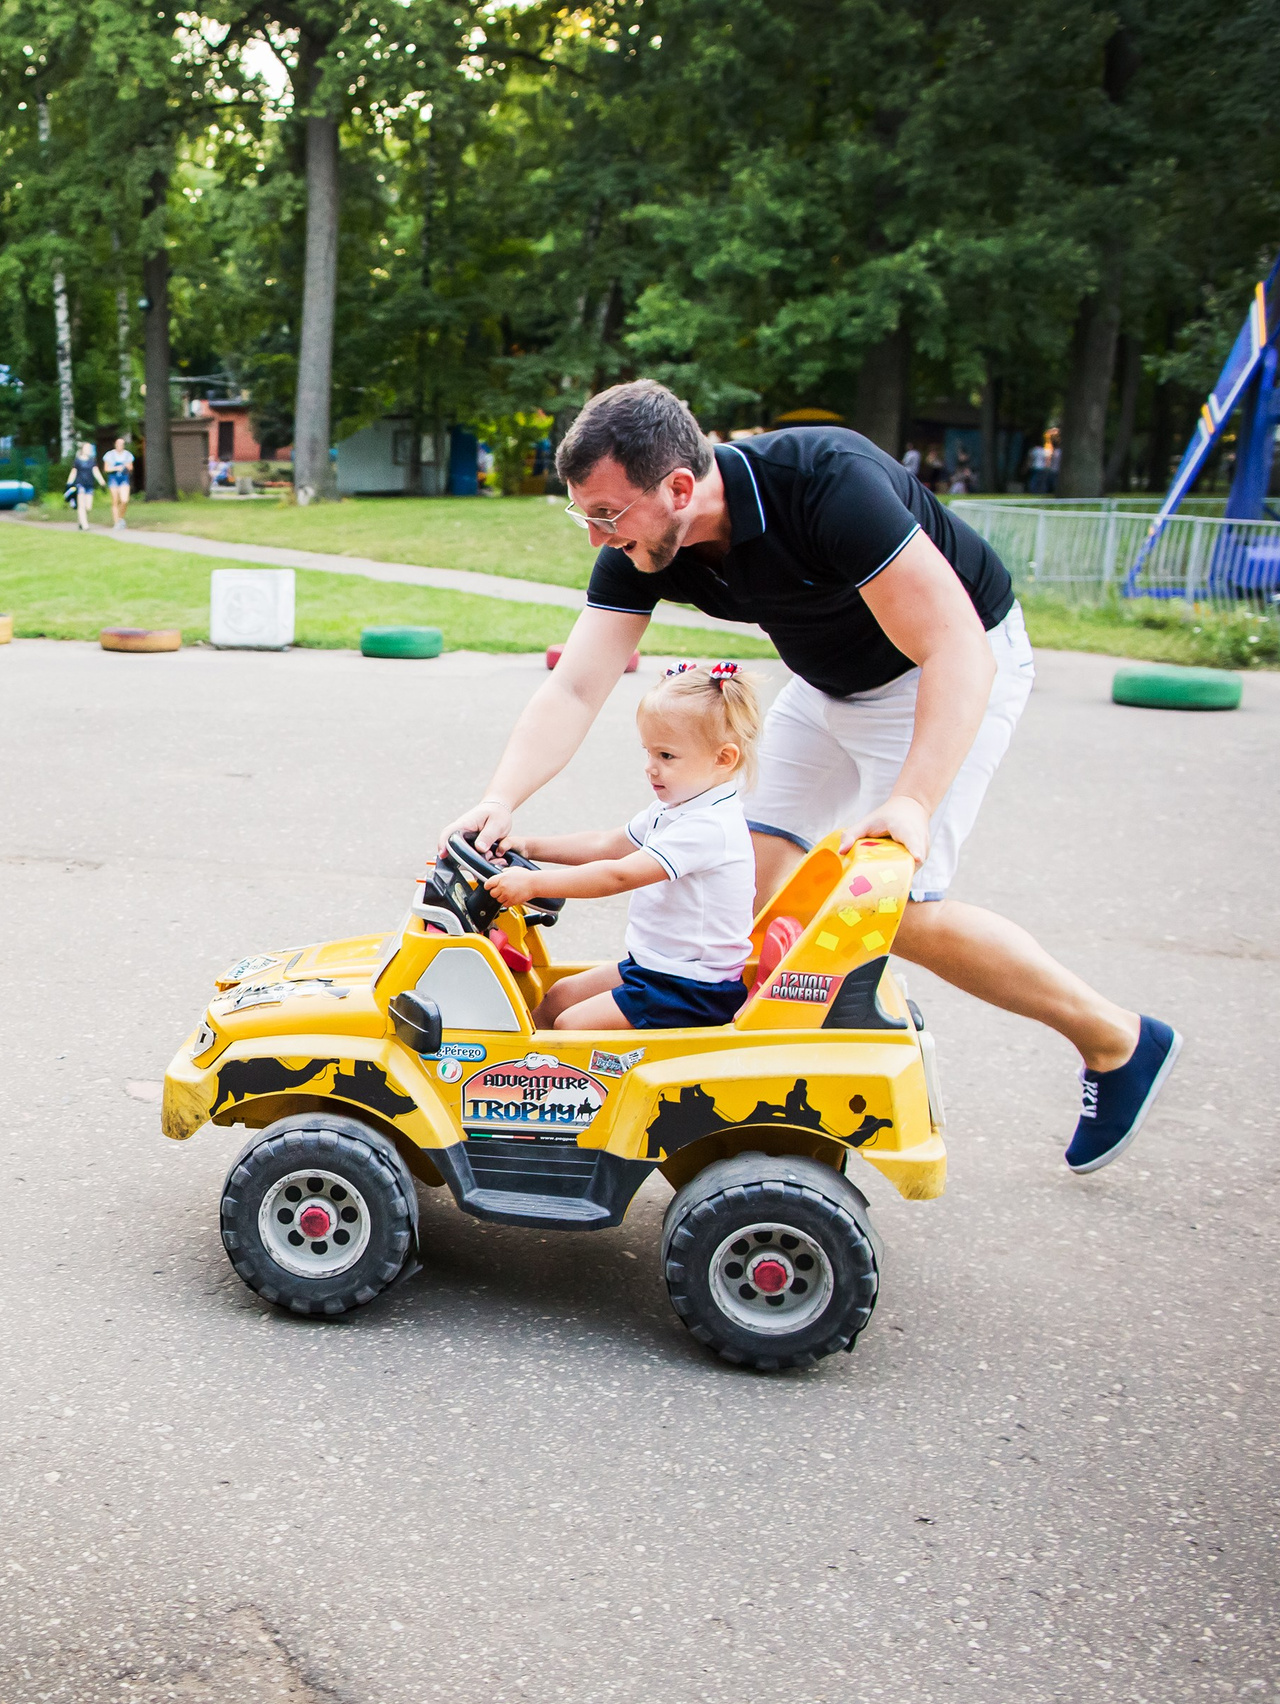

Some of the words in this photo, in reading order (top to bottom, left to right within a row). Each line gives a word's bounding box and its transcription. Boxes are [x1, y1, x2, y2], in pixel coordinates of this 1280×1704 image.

[771, 985, 829, 1002] POWERED
[483, 1074, 590, 1090] ADVENTURE
[467, 1099, 577, 1123] TROPHY
